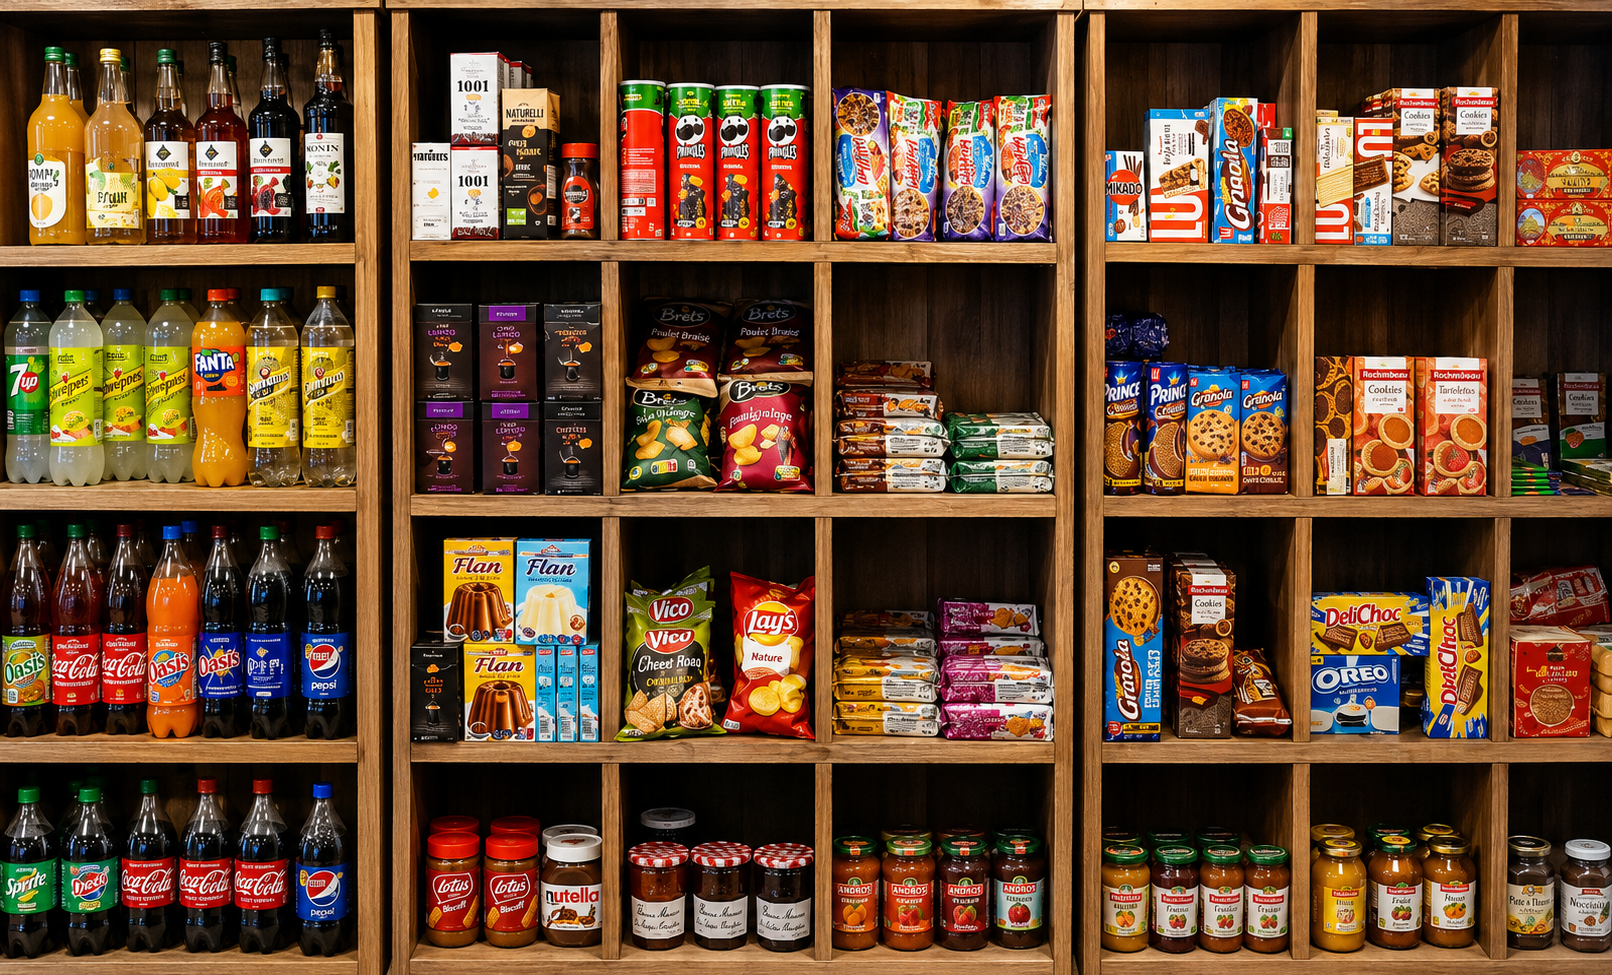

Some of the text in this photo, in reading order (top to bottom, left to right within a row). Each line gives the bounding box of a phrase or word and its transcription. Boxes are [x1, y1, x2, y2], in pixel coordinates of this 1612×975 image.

[457, 80, 489, 92] 1001
[458, 175, 489, 187] 1001
[195, 352, 236, 372] FANTA
[1242, 391, 1283, 410] Granola
[452, 557, 503, 575] Flan
[525, 558, 576, 577] Flan
[652, 600, 690, 622] Vico
[1325, 603, 1402, 627] DeliChoc
[747, 611, 796, 636] Lay's
[648, 630, 693, 649] Vico
[199, 650, 240, 678] Oasis
[474, 656, 524, 674] Flan
[751, 652, 783, 663] Nature
[4, 652, 46, 686] Oasis
[149, 653, 190, 683] Oasis
[311, 679, 337, 692] pepsi
[1315, 666, 1389, 693] OREO
[437, 876, 469, 894] Lotus
[494, 877, 526, 894] Lotus
[546, 887, 600, 904] nutella
